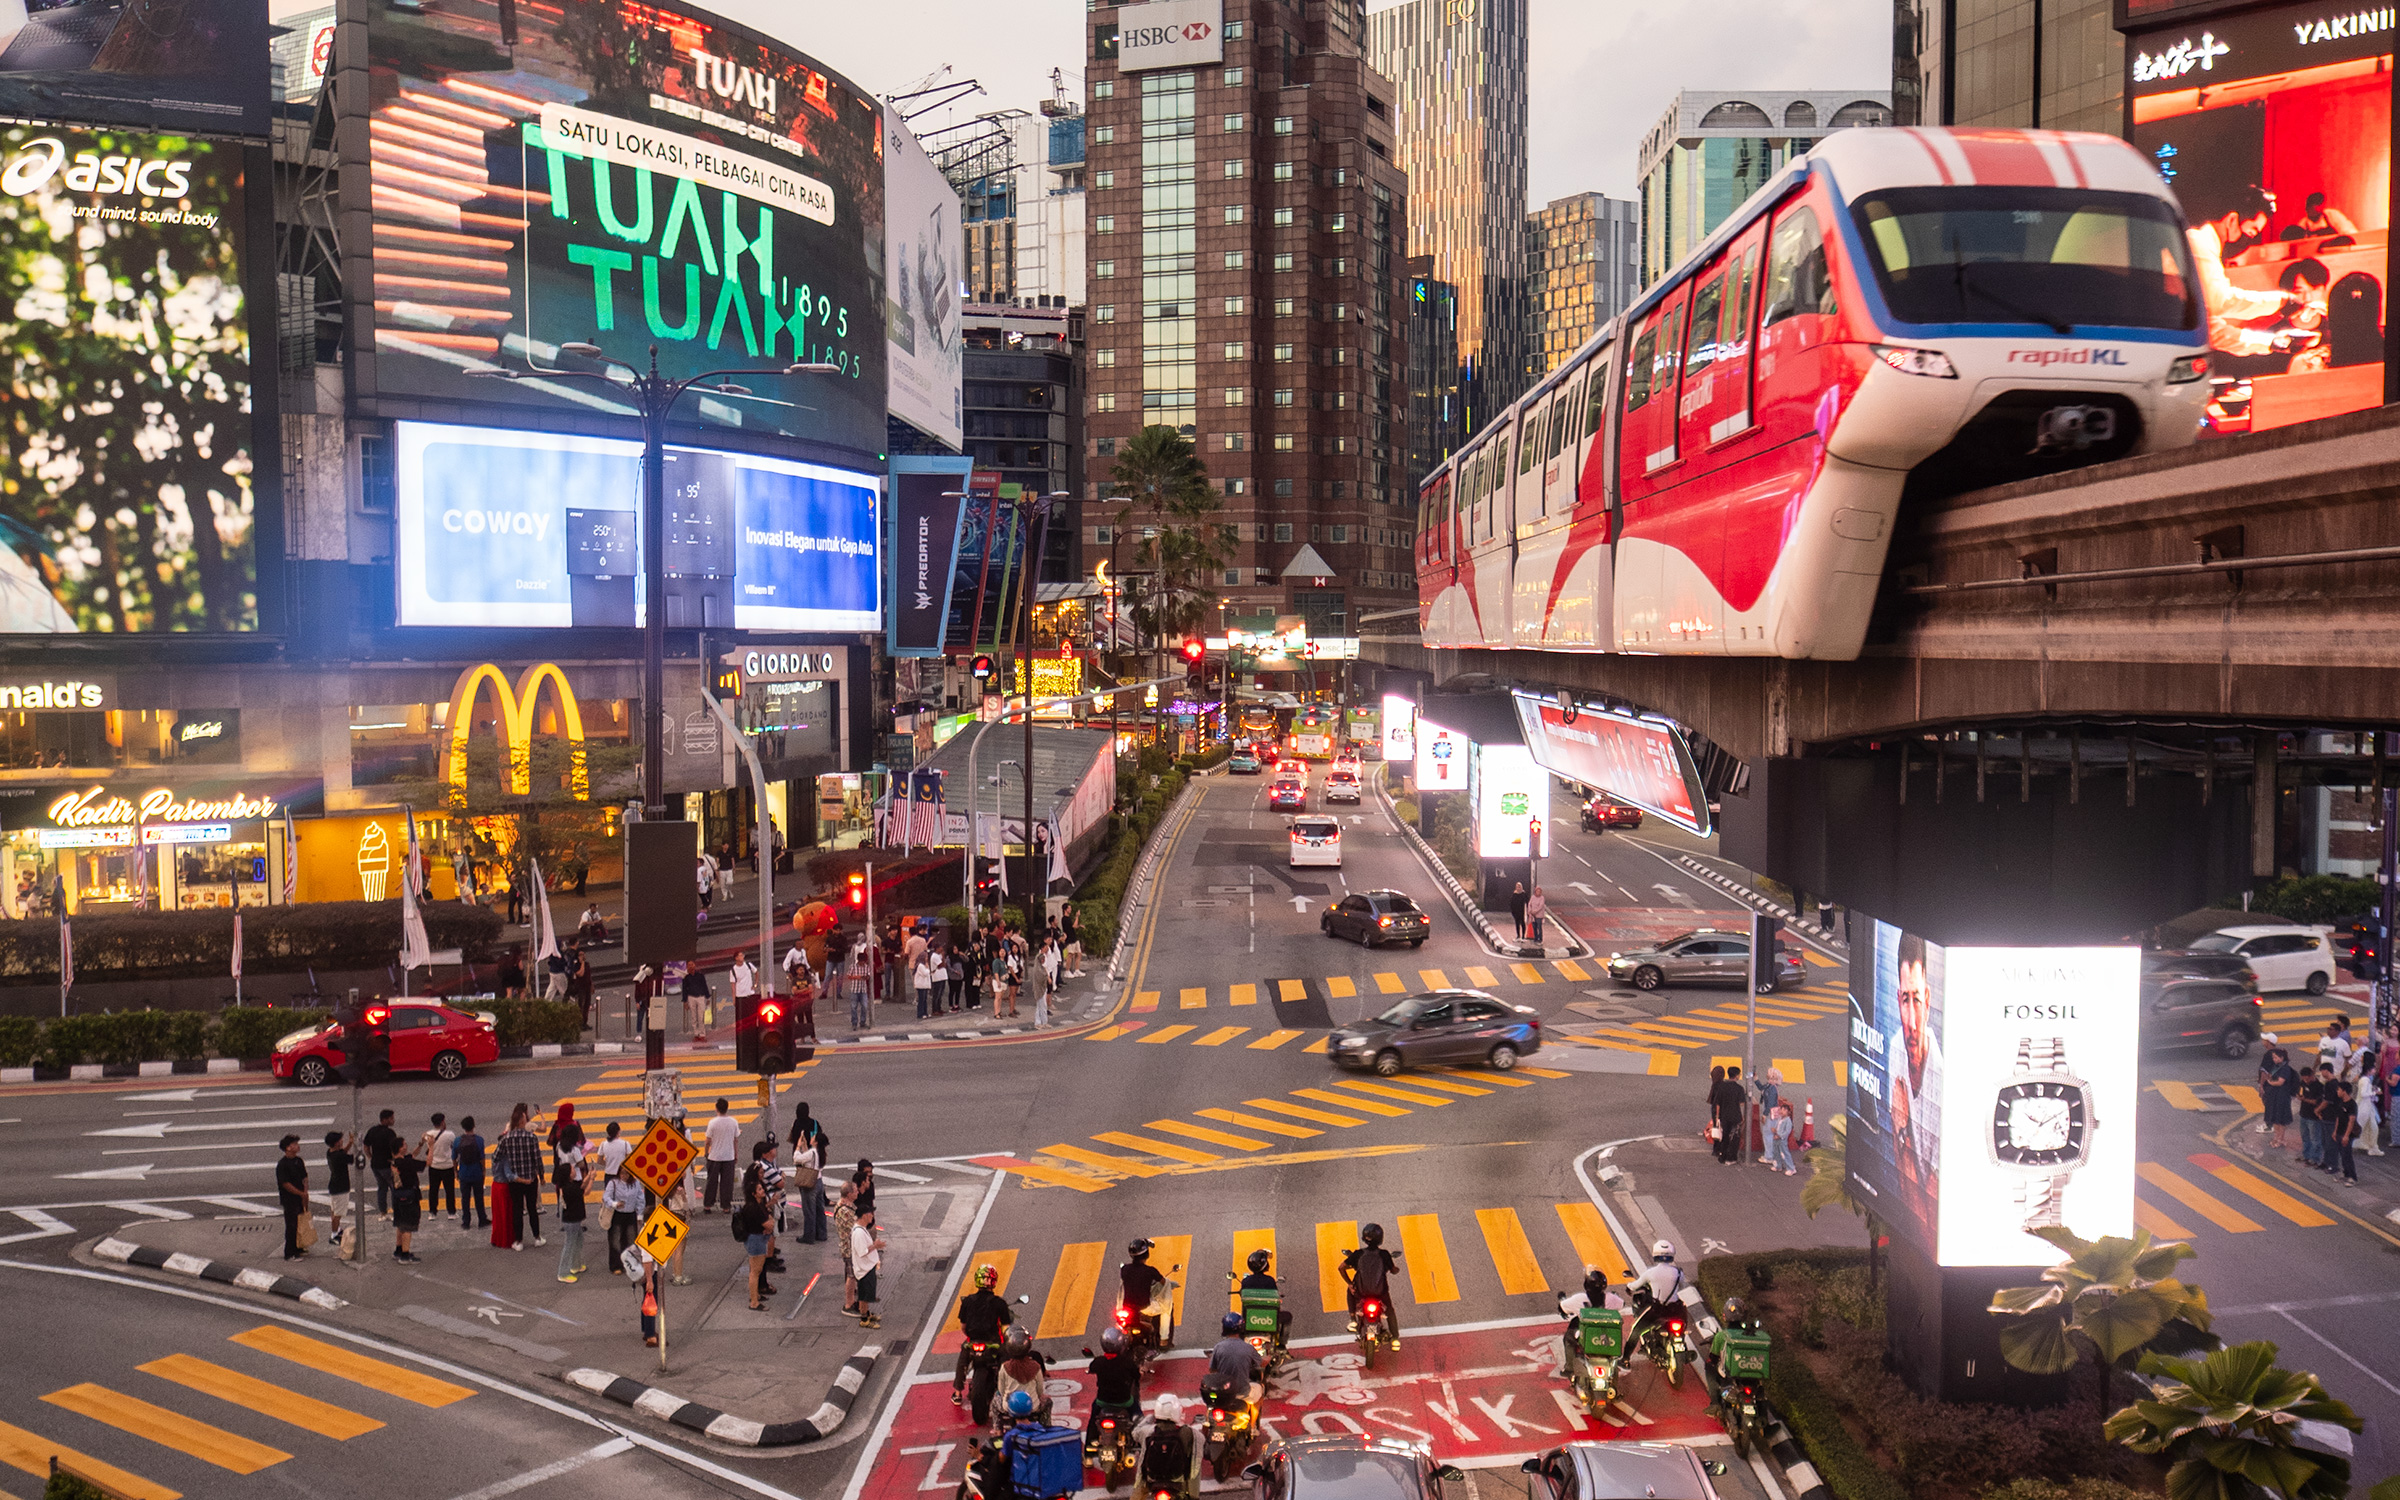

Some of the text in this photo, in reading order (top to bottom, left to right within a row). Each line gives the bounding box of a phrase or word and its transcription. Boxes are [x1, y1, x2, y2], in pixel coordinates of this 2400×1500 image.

[1124, 25, 1179, 48] HSBC
[689, 48, 777, 115] TUAH
[64, 153, 193, 199] asics
[559, 118, 828, 213] SATU LOKASI, PELBAGAI CITA RASA
[100, 205, 137, 223] mind,
[140, 209, 182, 225] sound
[182, 211, 219, 230] body
[782, 275, 849, 338] 1895
[442, 509, 551, 542] coway
[746, 526, 874, 558] Inovasi Elegan untuk Gaya Anda
[917, 515, 931, 591] PREDATOR
[745, 651, 834, 678] GIORDANO
[48, 785, 278, 828] Kadir Pasembor
[2003, 1005, 2080, 1019] FOSSIL
[1852, 1062, 1882, 1100] FOSSIL
[1249, 1315, 1274, 1327] Grab
[1738, 1359, 1763, 1370] Grab
